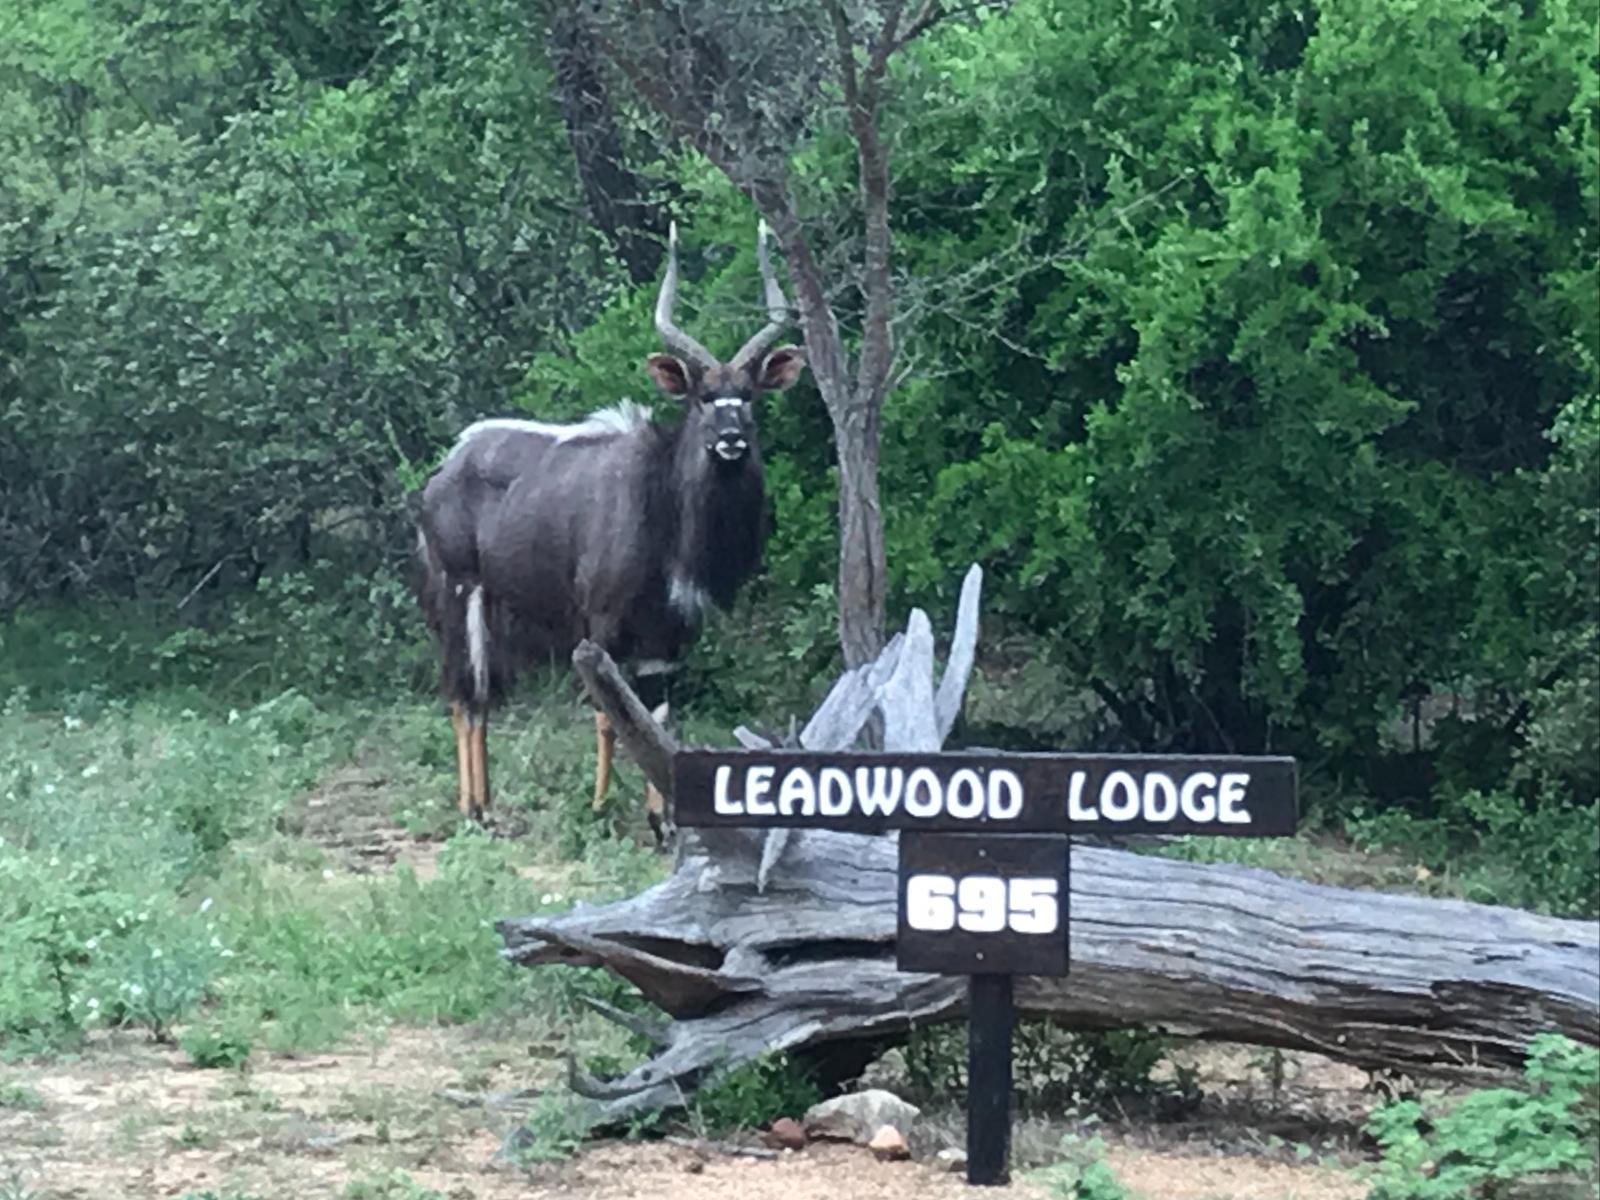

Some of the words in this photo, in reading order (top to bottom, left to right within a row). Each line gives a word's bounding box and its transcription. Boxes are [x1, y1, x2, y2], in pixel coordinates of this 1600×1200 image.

[714, 765, 1024, 820] LEADWOOD
[1068, 770, 1252, 824] LODGE
[906, 874, 1058, 934] 695
